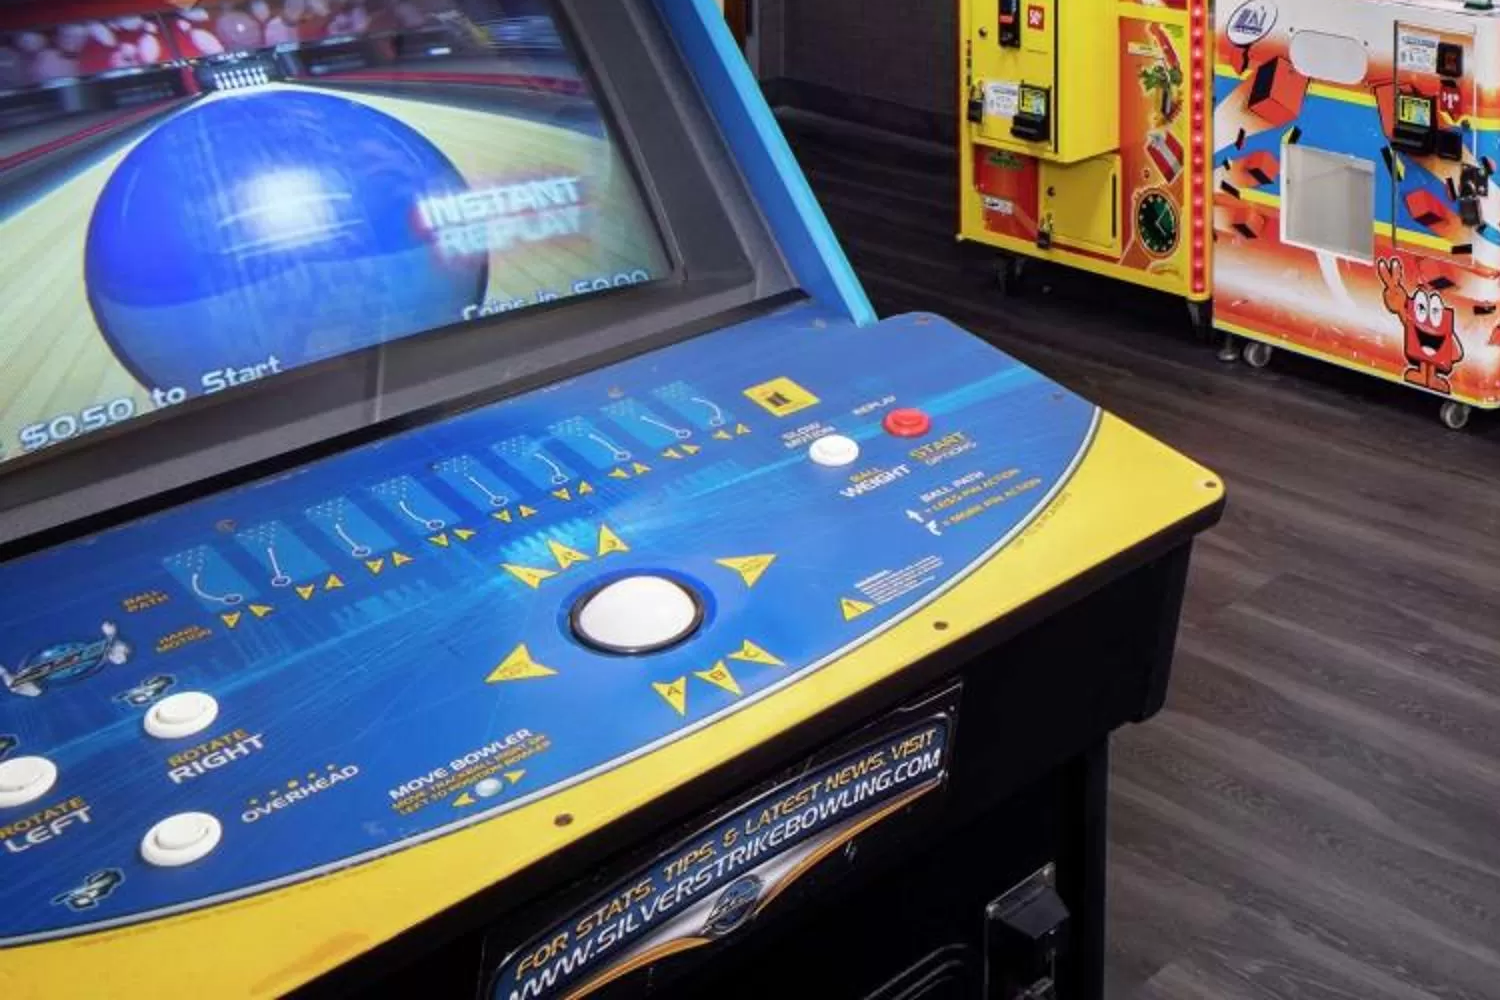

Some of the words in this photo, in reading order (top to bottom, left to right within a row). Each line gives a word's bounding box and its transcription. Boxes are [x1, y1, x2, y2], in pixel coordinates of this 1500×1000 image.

[417, 176, 582, 229] INSTANT
[152, 386, 188, 408] to
[201, 355, 282, 395] Start
[839, 462, 912, 498] WEIGHT
[167, 733, 266, 785] RIGHT
[168, 728, 250, 767] ROTATE
[388, 767, 449, 800] MOVE
[449, 728, 533, 771] BOWLER
[240, 763, 361, 825] OVERHEAD
[4, 805, 93, 853] LEFT
[515, 931, 569, 981] FOR
[743, 781, 822, 836] LATEST
[891, 728, 938, 761] VISIT
